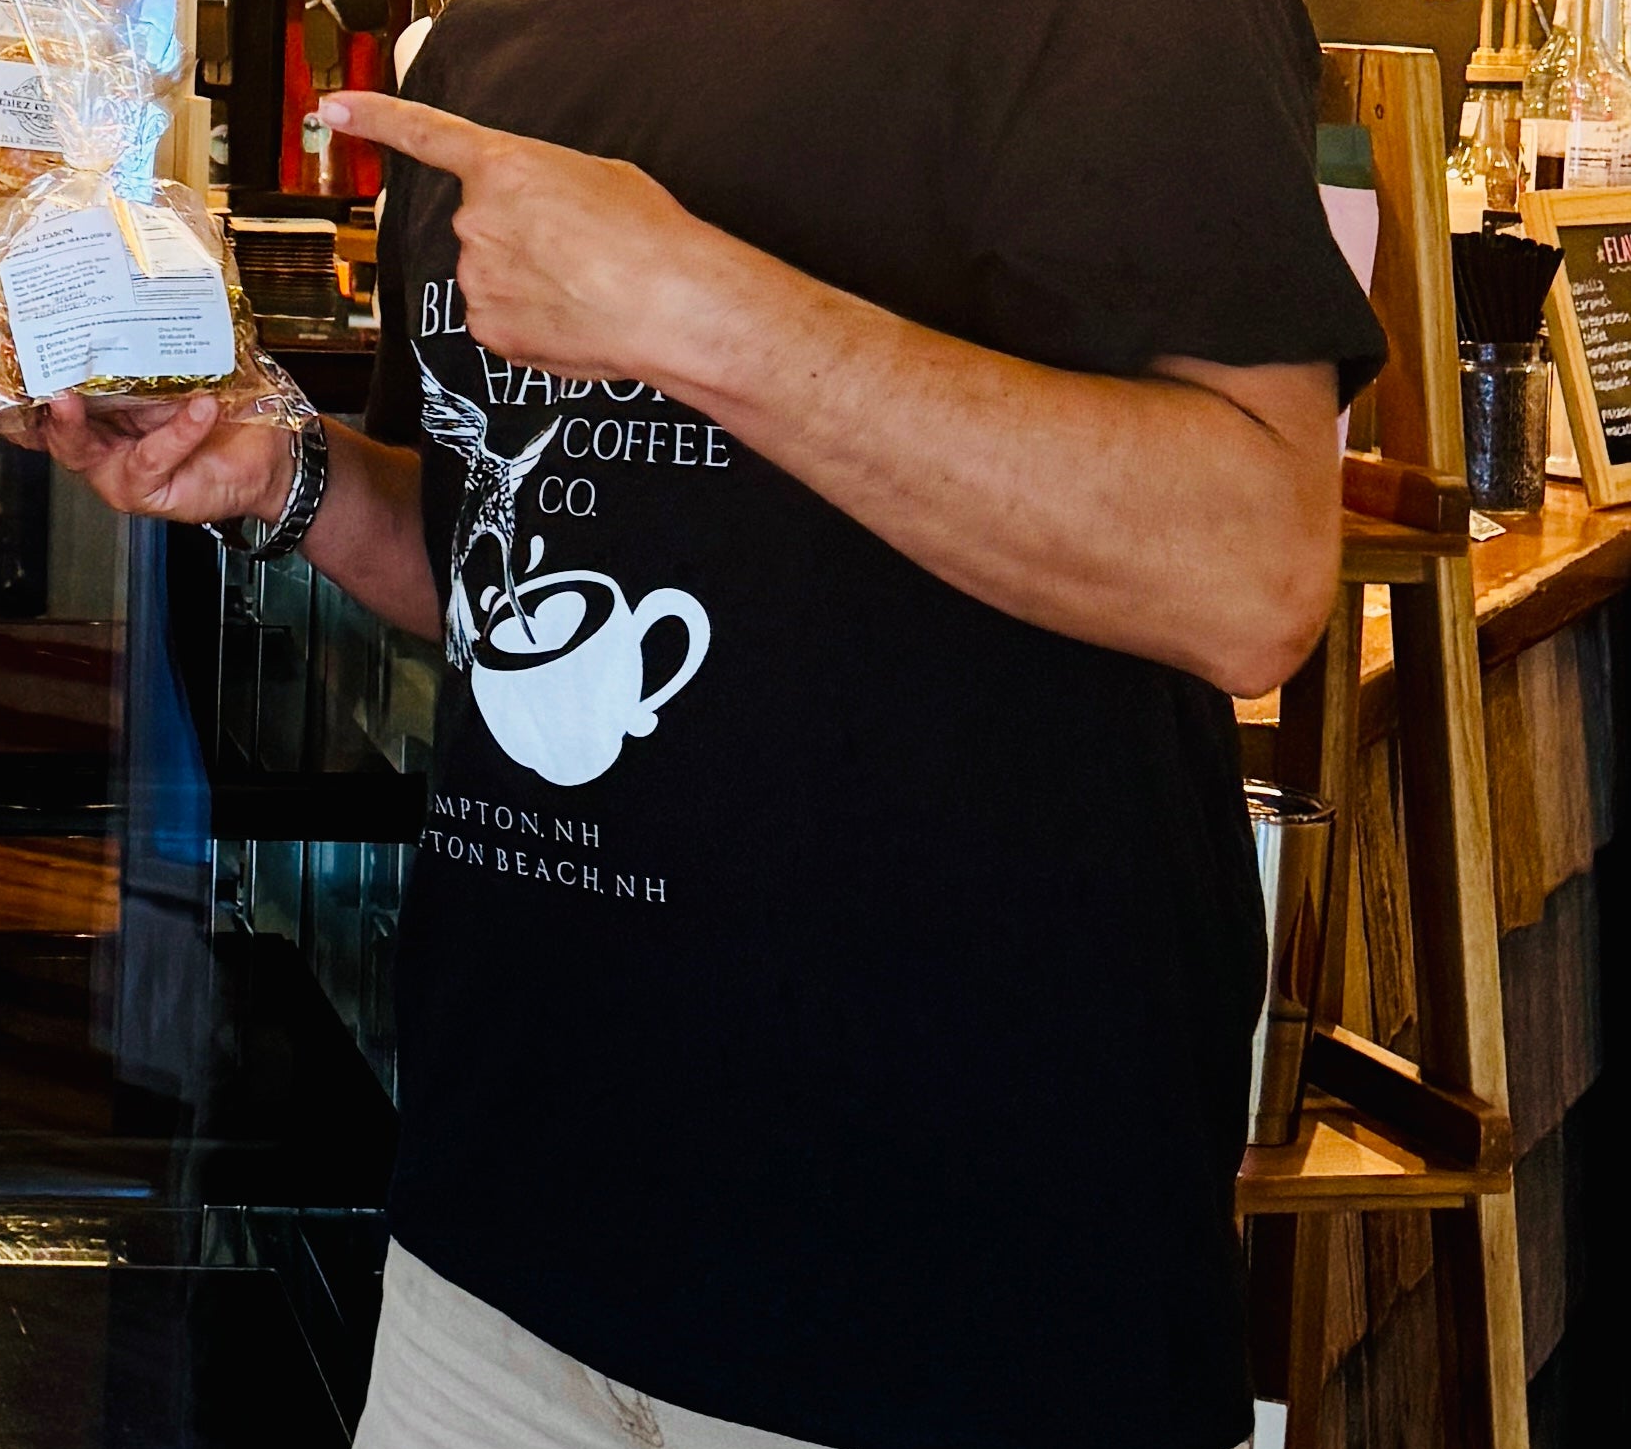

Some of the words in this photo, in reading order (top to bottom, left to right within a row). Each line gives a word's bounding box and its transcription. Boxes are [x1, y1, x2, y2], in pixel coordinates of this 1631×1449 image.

[420, 278, 467, 338] BL
[562, 417, 731, 468] COFFEE
[538, 475, 597, 518] CO.
[554, 818, 600, 848] NH
[615, 874, 666, 903] NH
